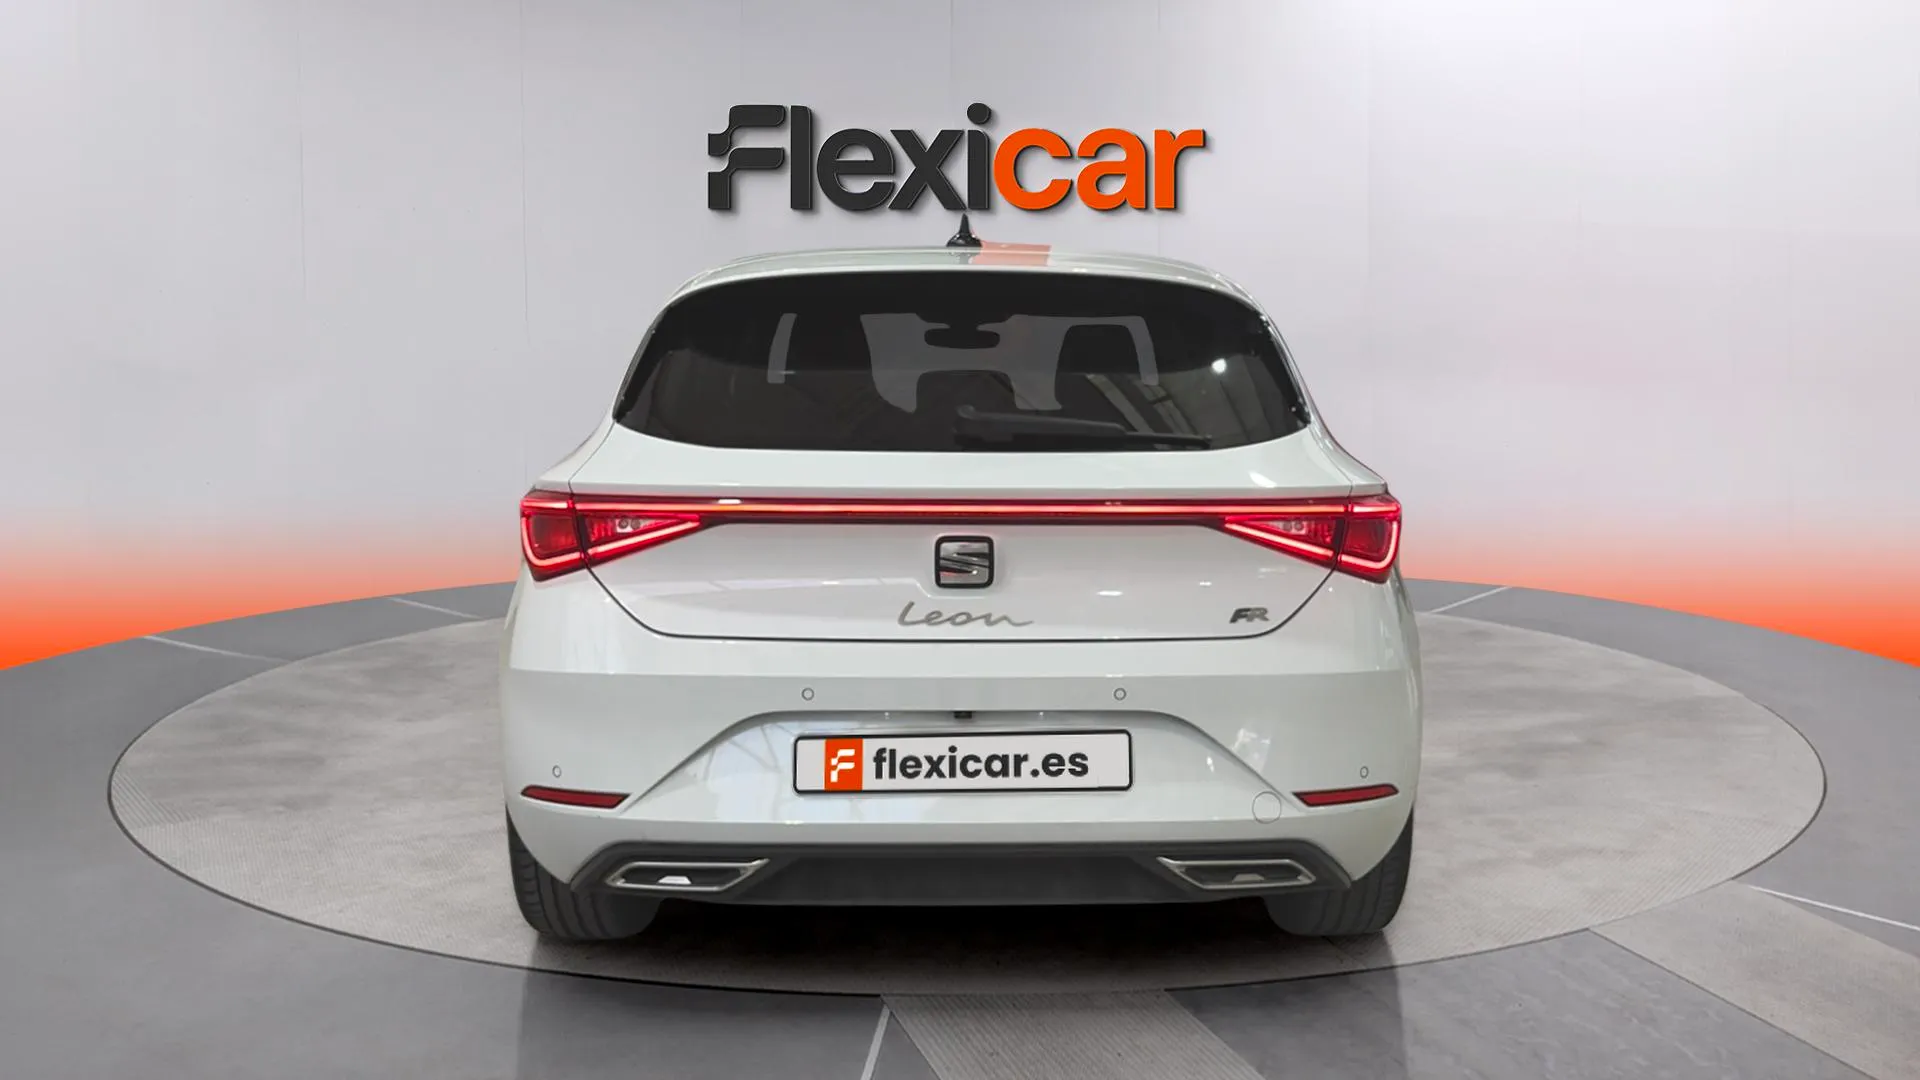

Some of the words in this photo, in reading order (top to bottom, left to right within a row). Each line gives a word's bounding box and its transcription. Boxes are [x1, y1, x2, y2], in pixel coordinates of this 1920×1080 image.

[708, 103, 1205, 211] Flexicar
[898, 601, 1033, 627] Leon
[1229, 607, 1270, 624] FR
[872, 745, 1089, 780] flexicar.es
